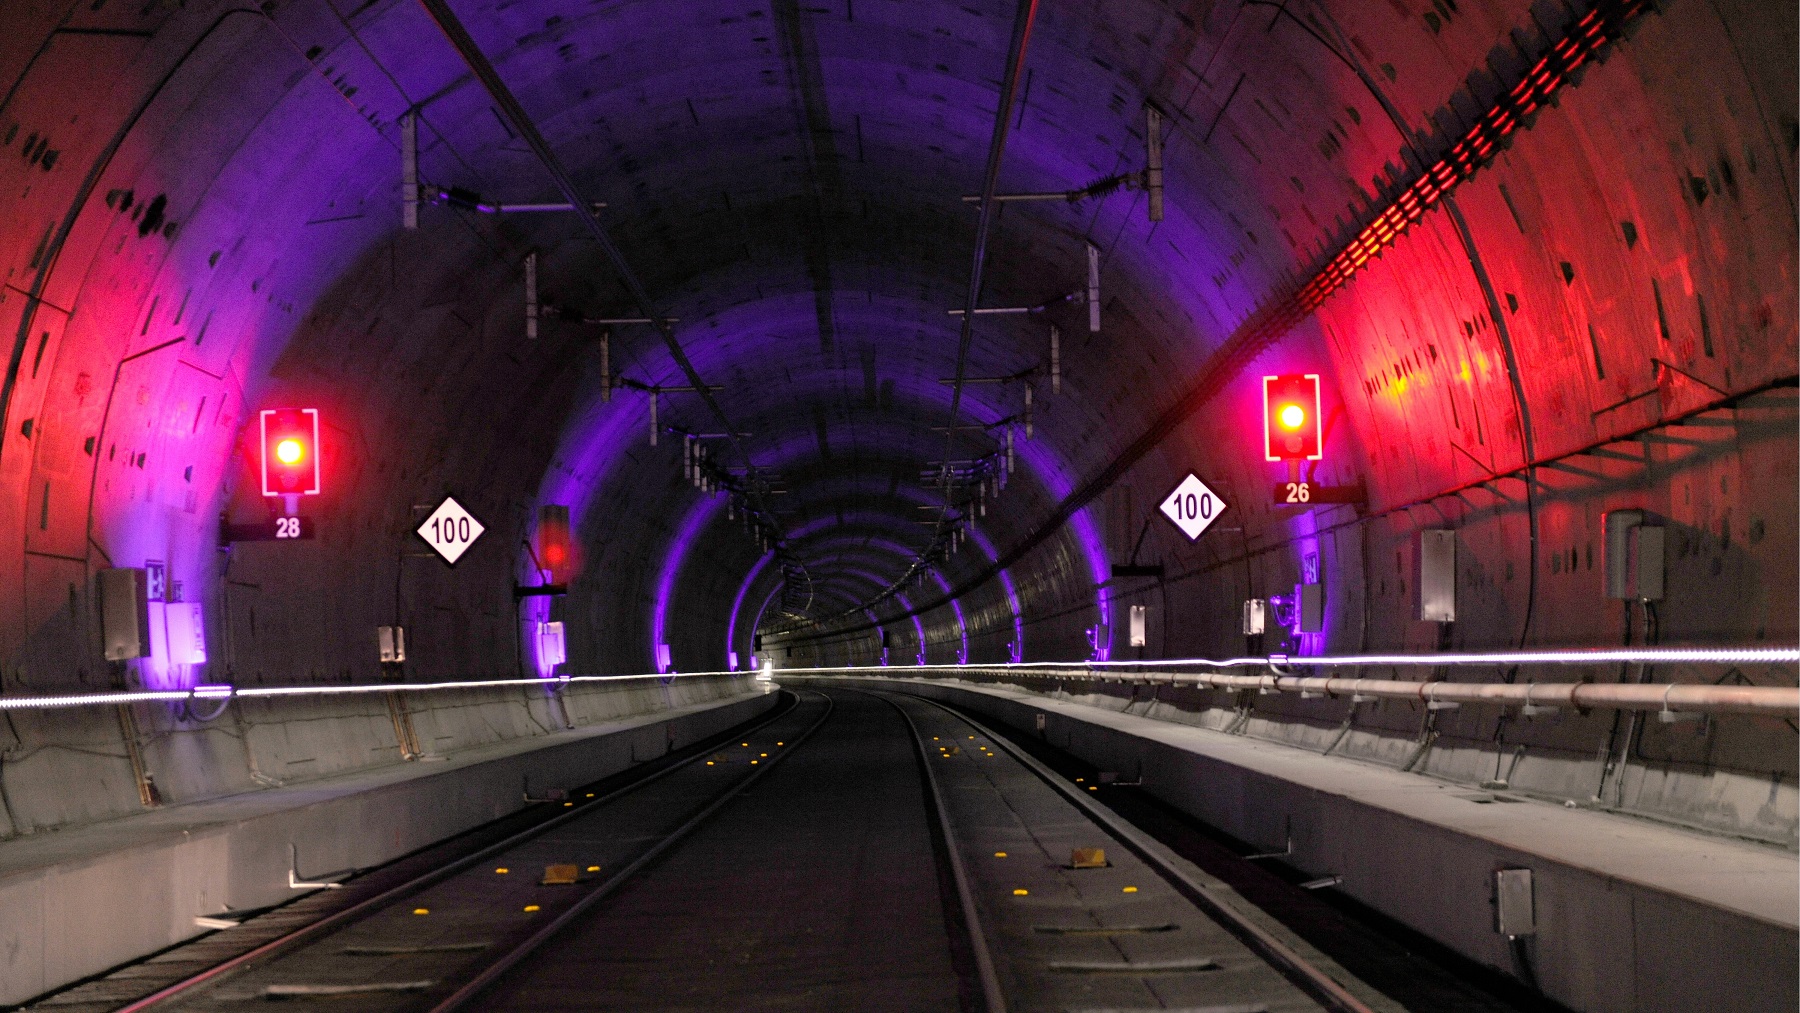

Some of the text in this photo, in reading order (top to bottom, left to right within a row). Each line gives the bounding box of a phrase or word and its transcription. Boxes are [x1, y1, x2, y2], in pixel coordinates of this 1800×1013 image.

[1286, 482, 1310, 503] 26
[1173, 493, 1212, 519] 100
[275, 517, 300, 538] 28
[431, 516, 470, 544] 100
